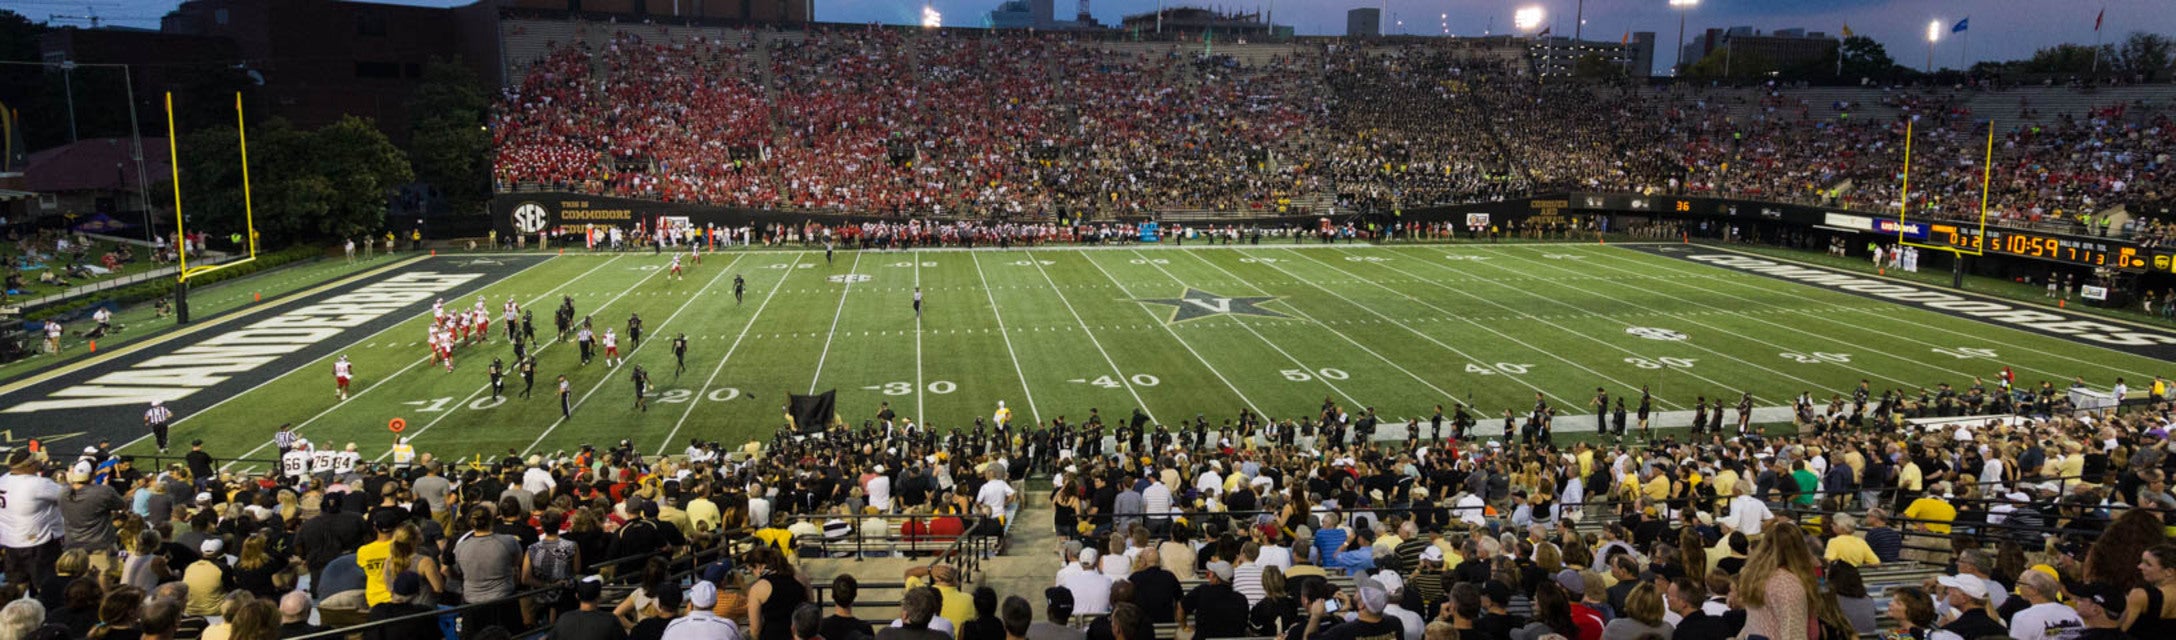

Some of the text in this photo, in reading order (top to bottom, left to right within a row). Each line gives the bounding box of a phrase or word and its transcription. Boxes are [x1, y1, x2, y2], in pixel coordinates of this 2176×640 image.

[1676, 201, 1690, 211] 36
[513, 203, 547, 232] SEC
[561, 210, 631, 220] COMMODORE
[2006, 235, 2058, 258] 10:59
[1686, 254, 2176, 346] COMMODORES
[1, 271, 487, 414] VANDERBILT
[1279, 366, 1350, 382] 50
[1465, 361, 1531, 376] 40
[881, 379, 958, 396] 30
[1085, 373, 1160, 389] 40
[655, 387, 741, 403] 20
[415, 395, 507, 412] 10
